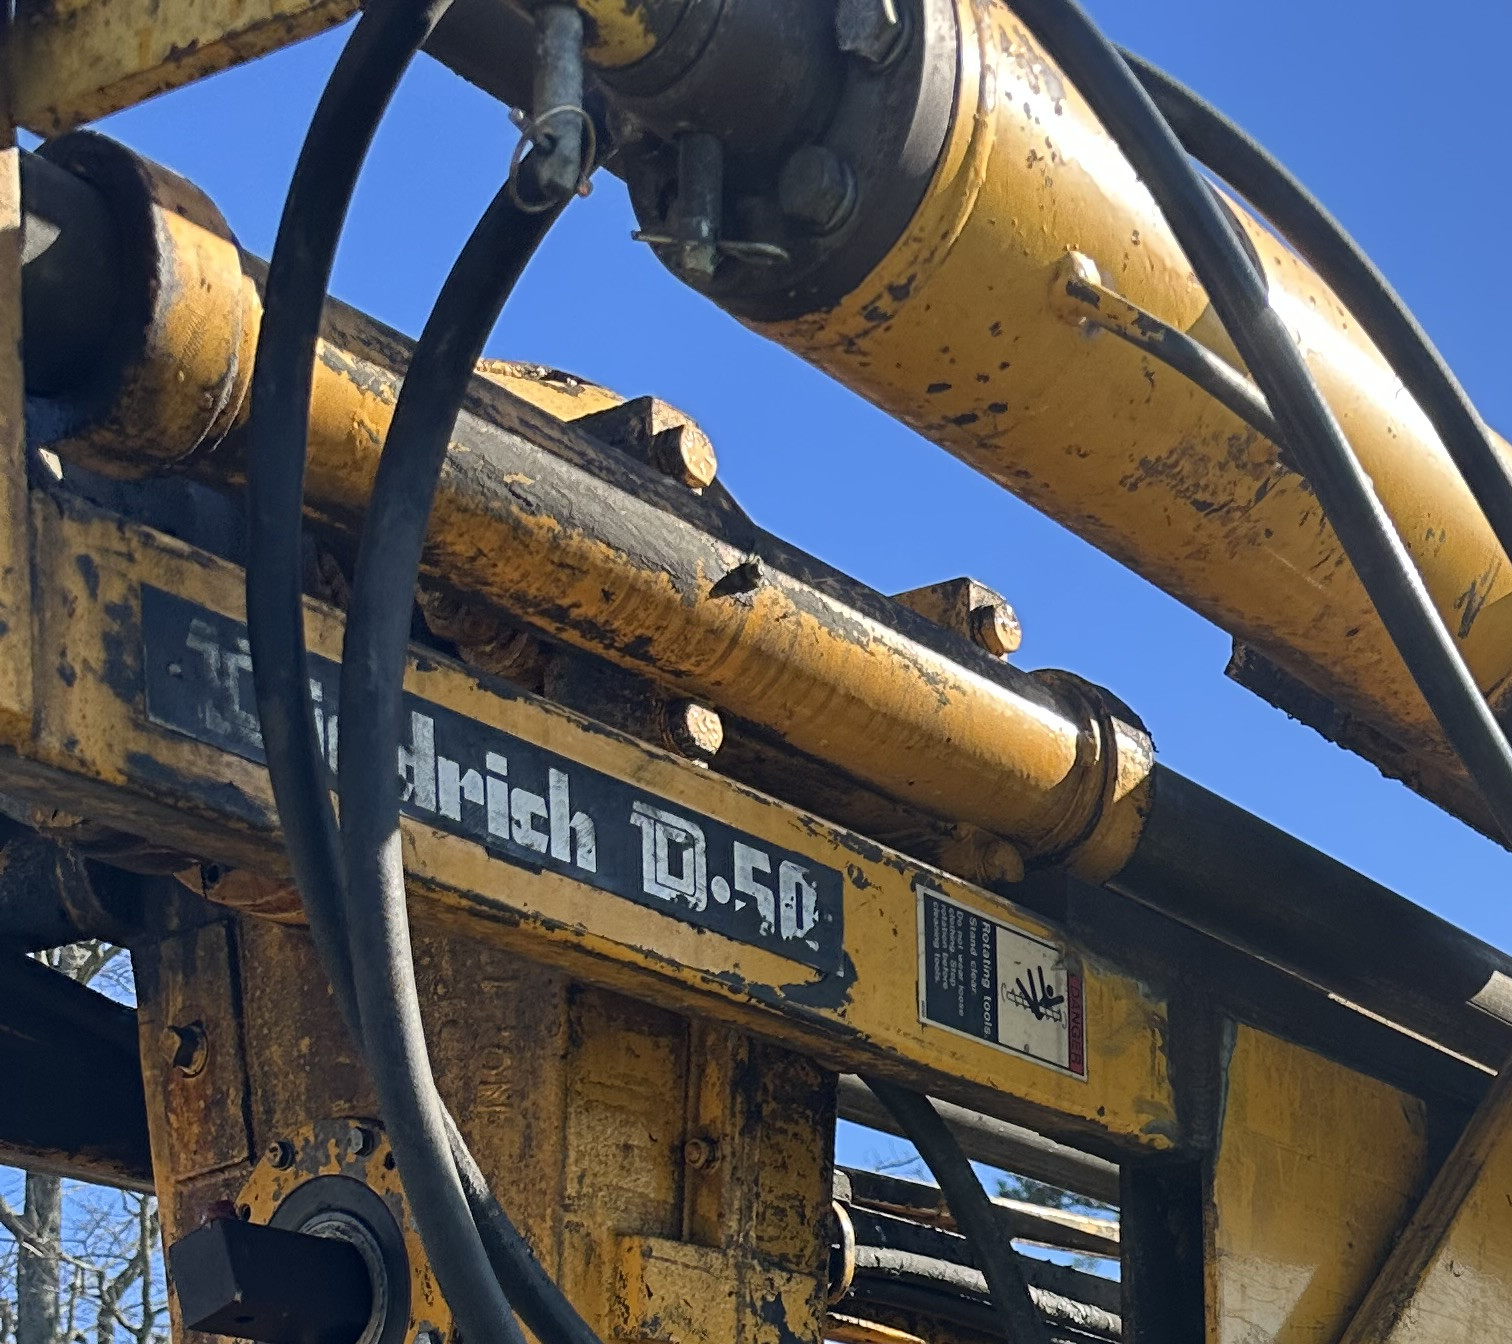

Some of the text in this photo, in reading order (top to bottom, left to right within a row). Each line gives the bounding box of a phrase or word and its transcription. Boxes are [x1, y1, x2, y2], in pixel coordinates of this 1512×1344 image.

[931, 901, 940, 949] cleaning
[956, 911, 963, 928] Do
[968, 917, 977, 956] Stand
[940, 904, 949, 991] rotation before
[980, 921, 992, 990] Rotating
[957, 985, 965, 1017] loose
[1069, 985, 1081, 1066] DANGER
